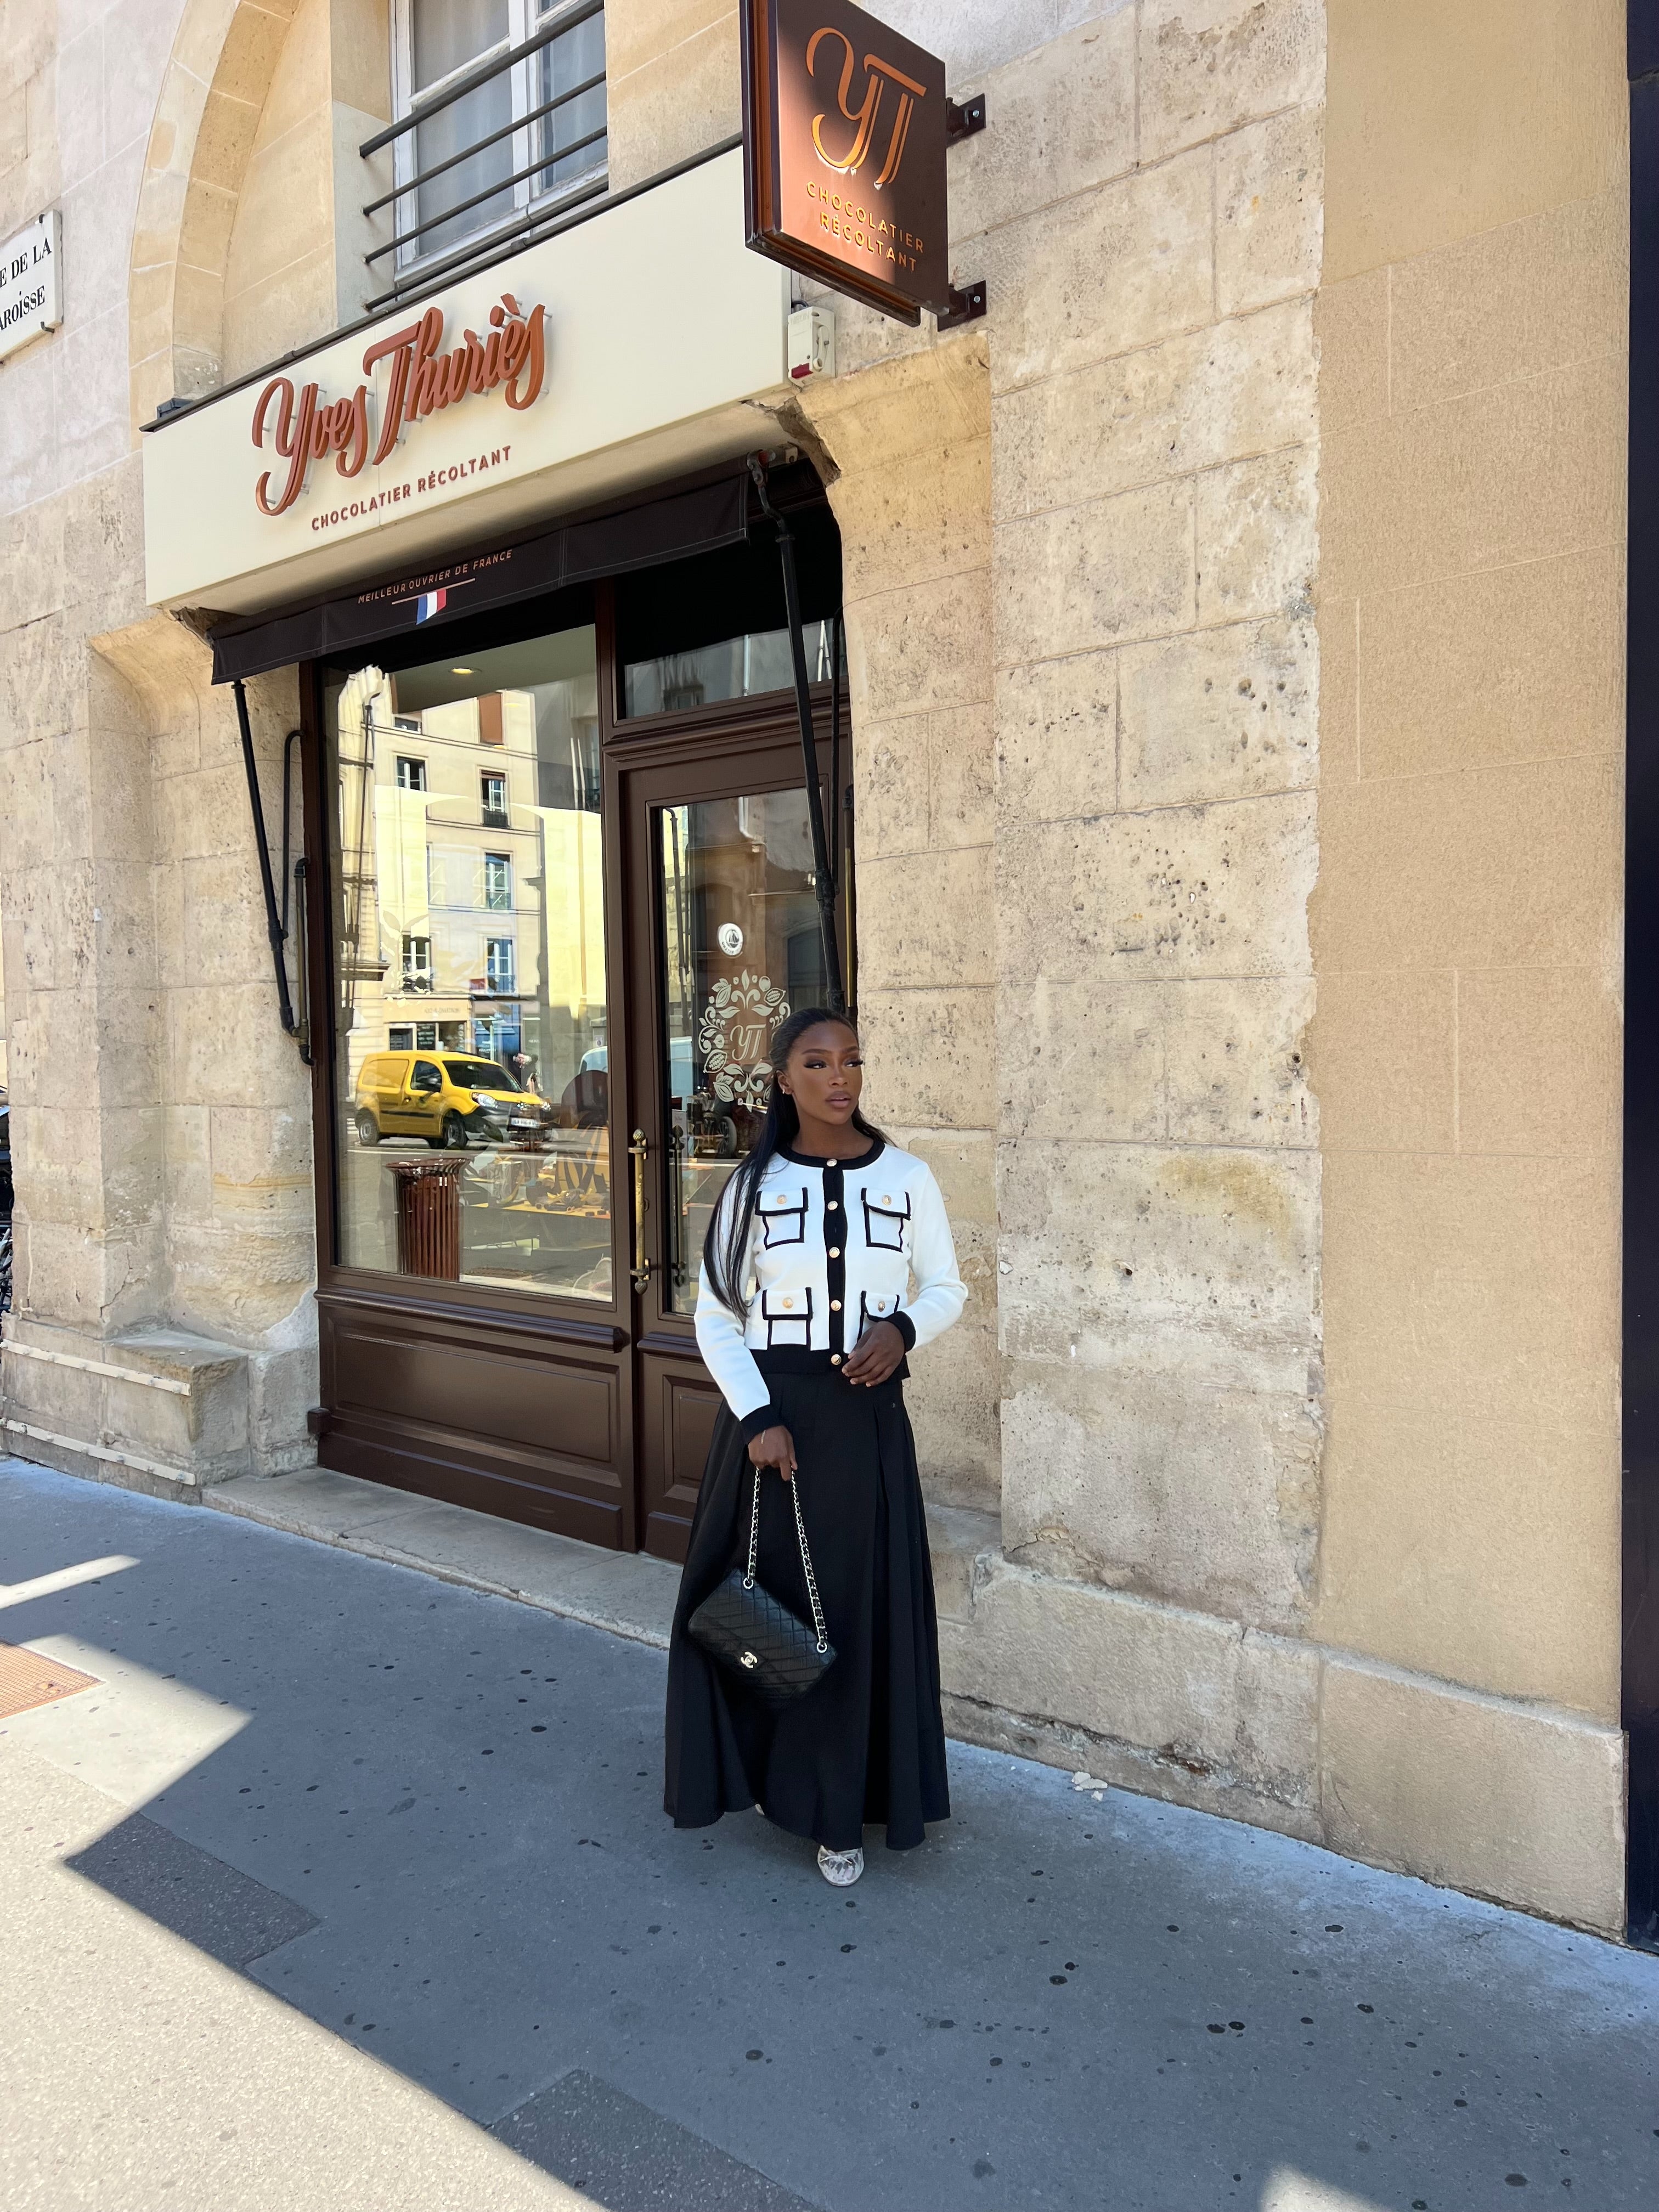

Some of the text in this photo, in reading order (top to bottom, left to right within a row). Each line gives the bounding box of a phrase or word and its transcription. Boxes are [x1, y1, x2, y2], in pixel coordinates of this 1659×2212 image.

[806, 180, 924, 253] CHOCOLATIER
[820, 211, 917, 271] RÉCOLTANT
[11, 252, 27, 280] DE
[33, 237, 52, 264] LA
[252, 293, 545, 516] Yves Thuriès
[311, 445, 511, 531] CHOCOLATIER RÉCOLTANT
[358, 549, 513, 604] MEILLEUR OUVRIER DE FRANCE
